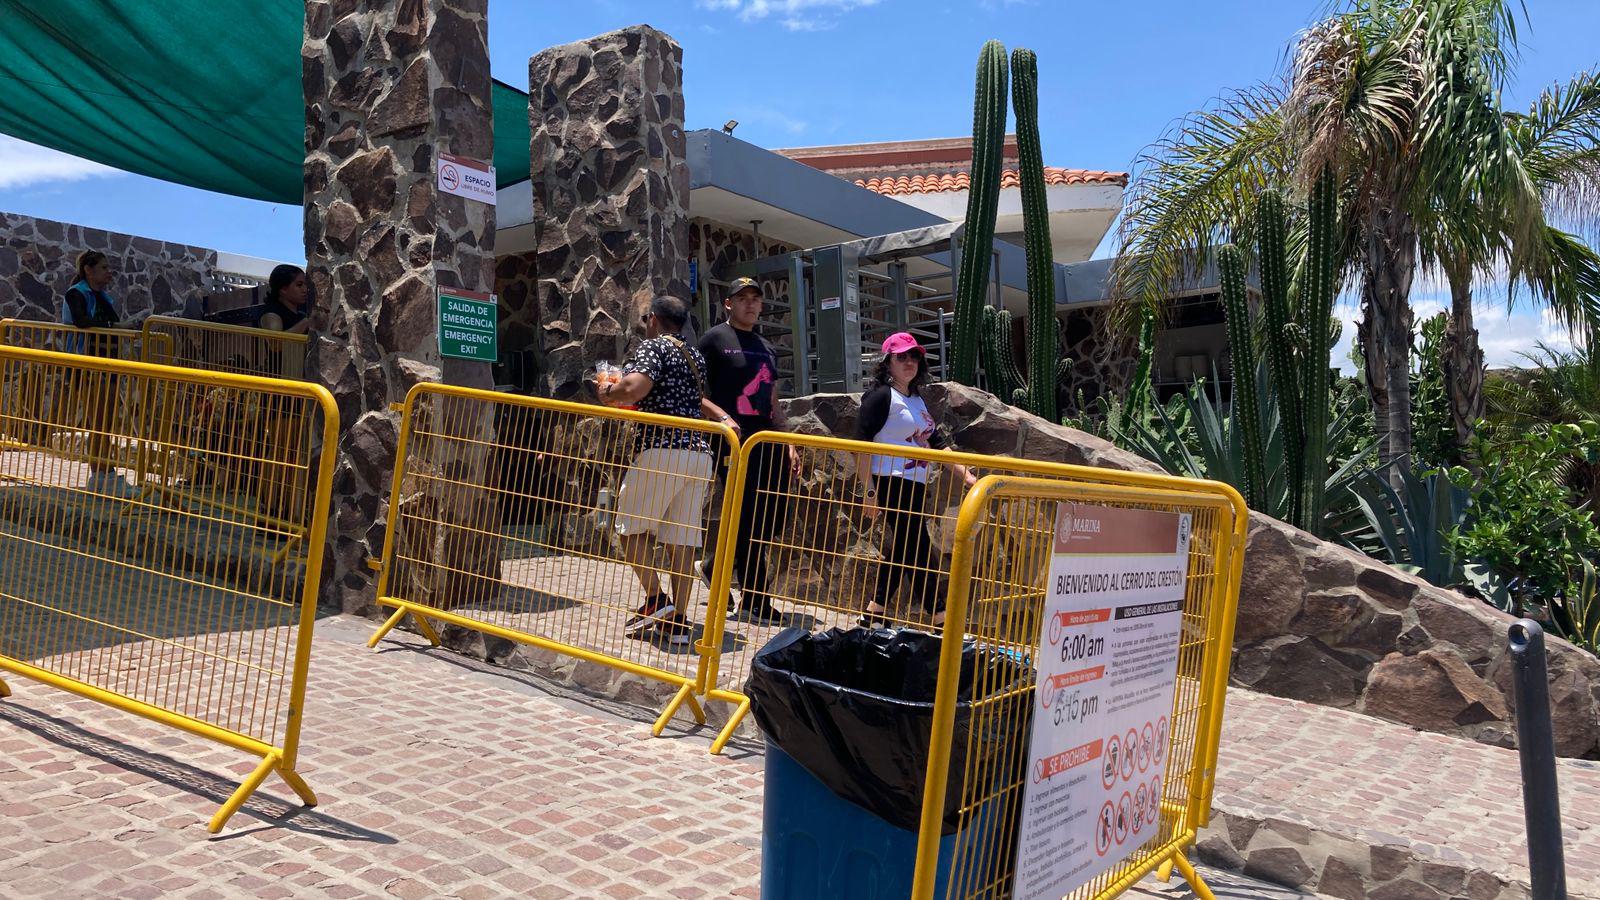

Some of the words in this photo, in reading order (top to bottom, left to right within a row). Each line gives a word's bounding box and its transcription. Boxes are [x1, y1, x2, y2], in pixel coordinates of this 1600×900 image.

[465, 175, 491, 188] ESPACIO
[448, 301, 476, 314] SALIDA
[478, 306, 488, 316] DE
[443, 312, 494, 329] EMERGENCIA
[445, 330, 493, 345] EMERGENCY
[460, 344, 478, 355] EXIT
[1072, 518, 1100, 533] MARINA
[1057, 573, 1109, 595] BIENVENIDO
[1110, 573, 1119, 591] AL
[1120, 571, 1143, 590] CERRO
[1144, 570, 1157, 589] DEL
[1157, 566, 1184, 588] CRESTÓN
[1061, 634, 1086, 662] 6:00
[1087, 636, 1104, 657] am
[1081, 695, 1098, 723] pm
[1049, 756, 1059, 775] SE
